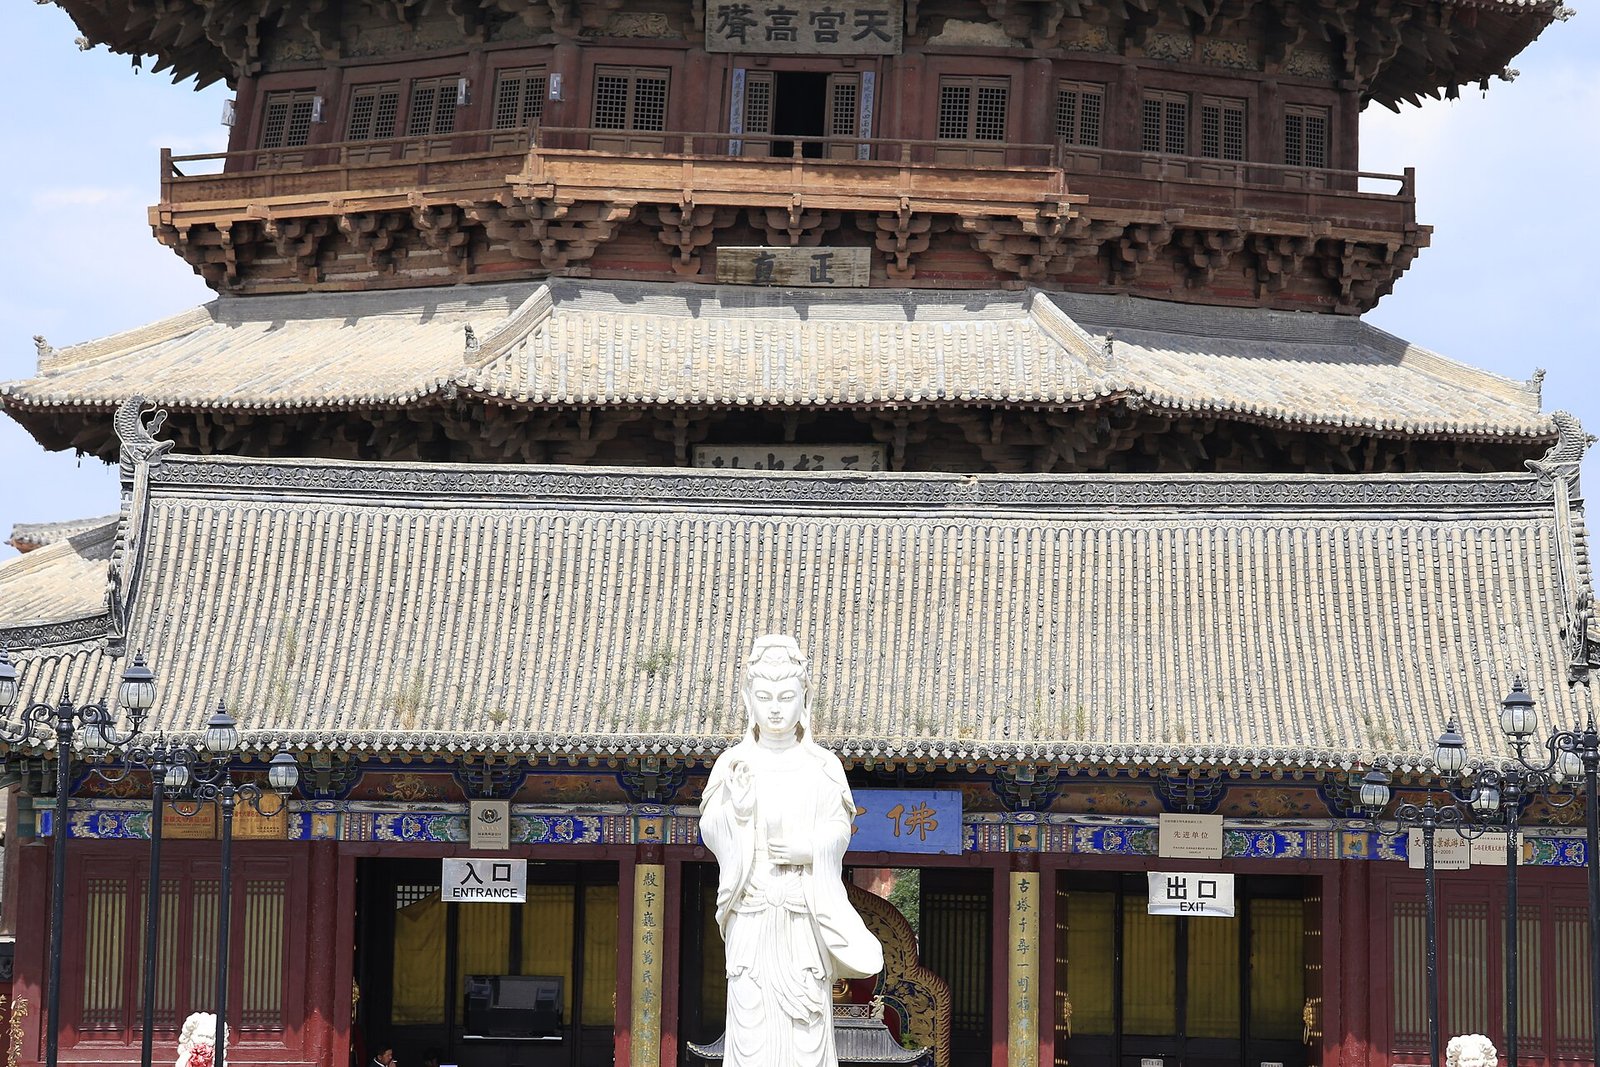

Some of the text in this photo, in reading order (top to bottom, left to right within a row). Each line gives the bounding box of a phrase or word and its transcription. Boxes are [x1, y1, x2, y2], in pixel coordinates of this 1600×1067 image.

[850, 801, 939, 842] 佛
[460, 862, 511, 885] 入口
[452, 887, 518, 899] ENTRANCE
[1166, 876, 1217, 900] 出口
[1179, 901, 1206, 912] EXIT
